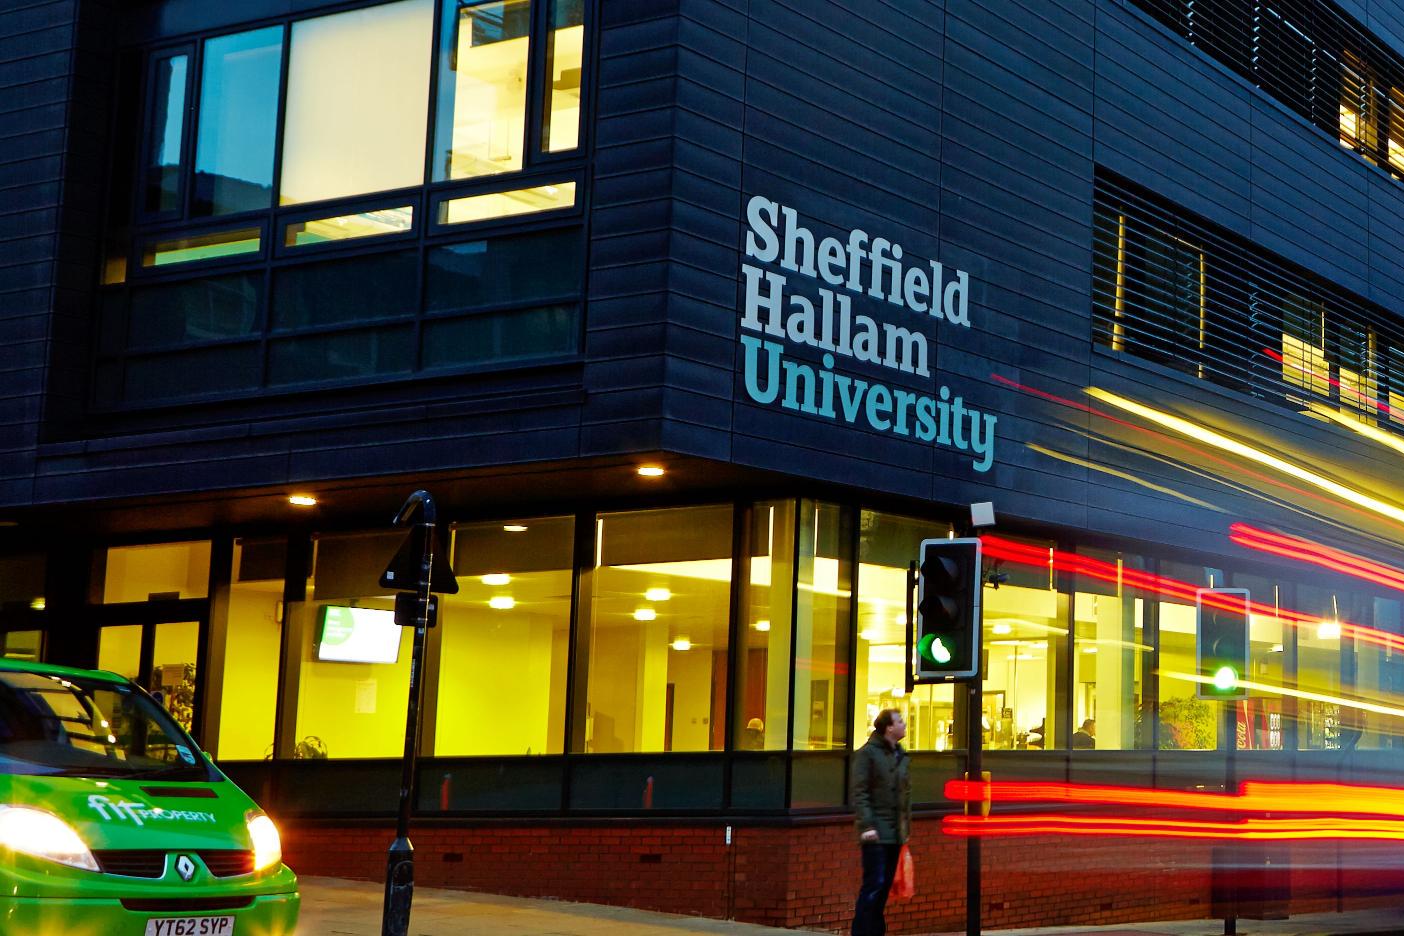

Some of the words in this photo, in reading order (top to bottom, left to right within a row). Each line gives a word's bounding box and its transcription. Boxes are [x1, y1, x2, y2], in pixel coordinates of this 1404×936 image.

[745, 194, 971, 328] Sheffield
[740, 263, 930, 378] Hallam
[740, 334, 997, 473] University
[138, 808, 217, 823] PROPERTY
[154, 918, 196, 936] YT62
[199, 917, 229, 935] SYP
